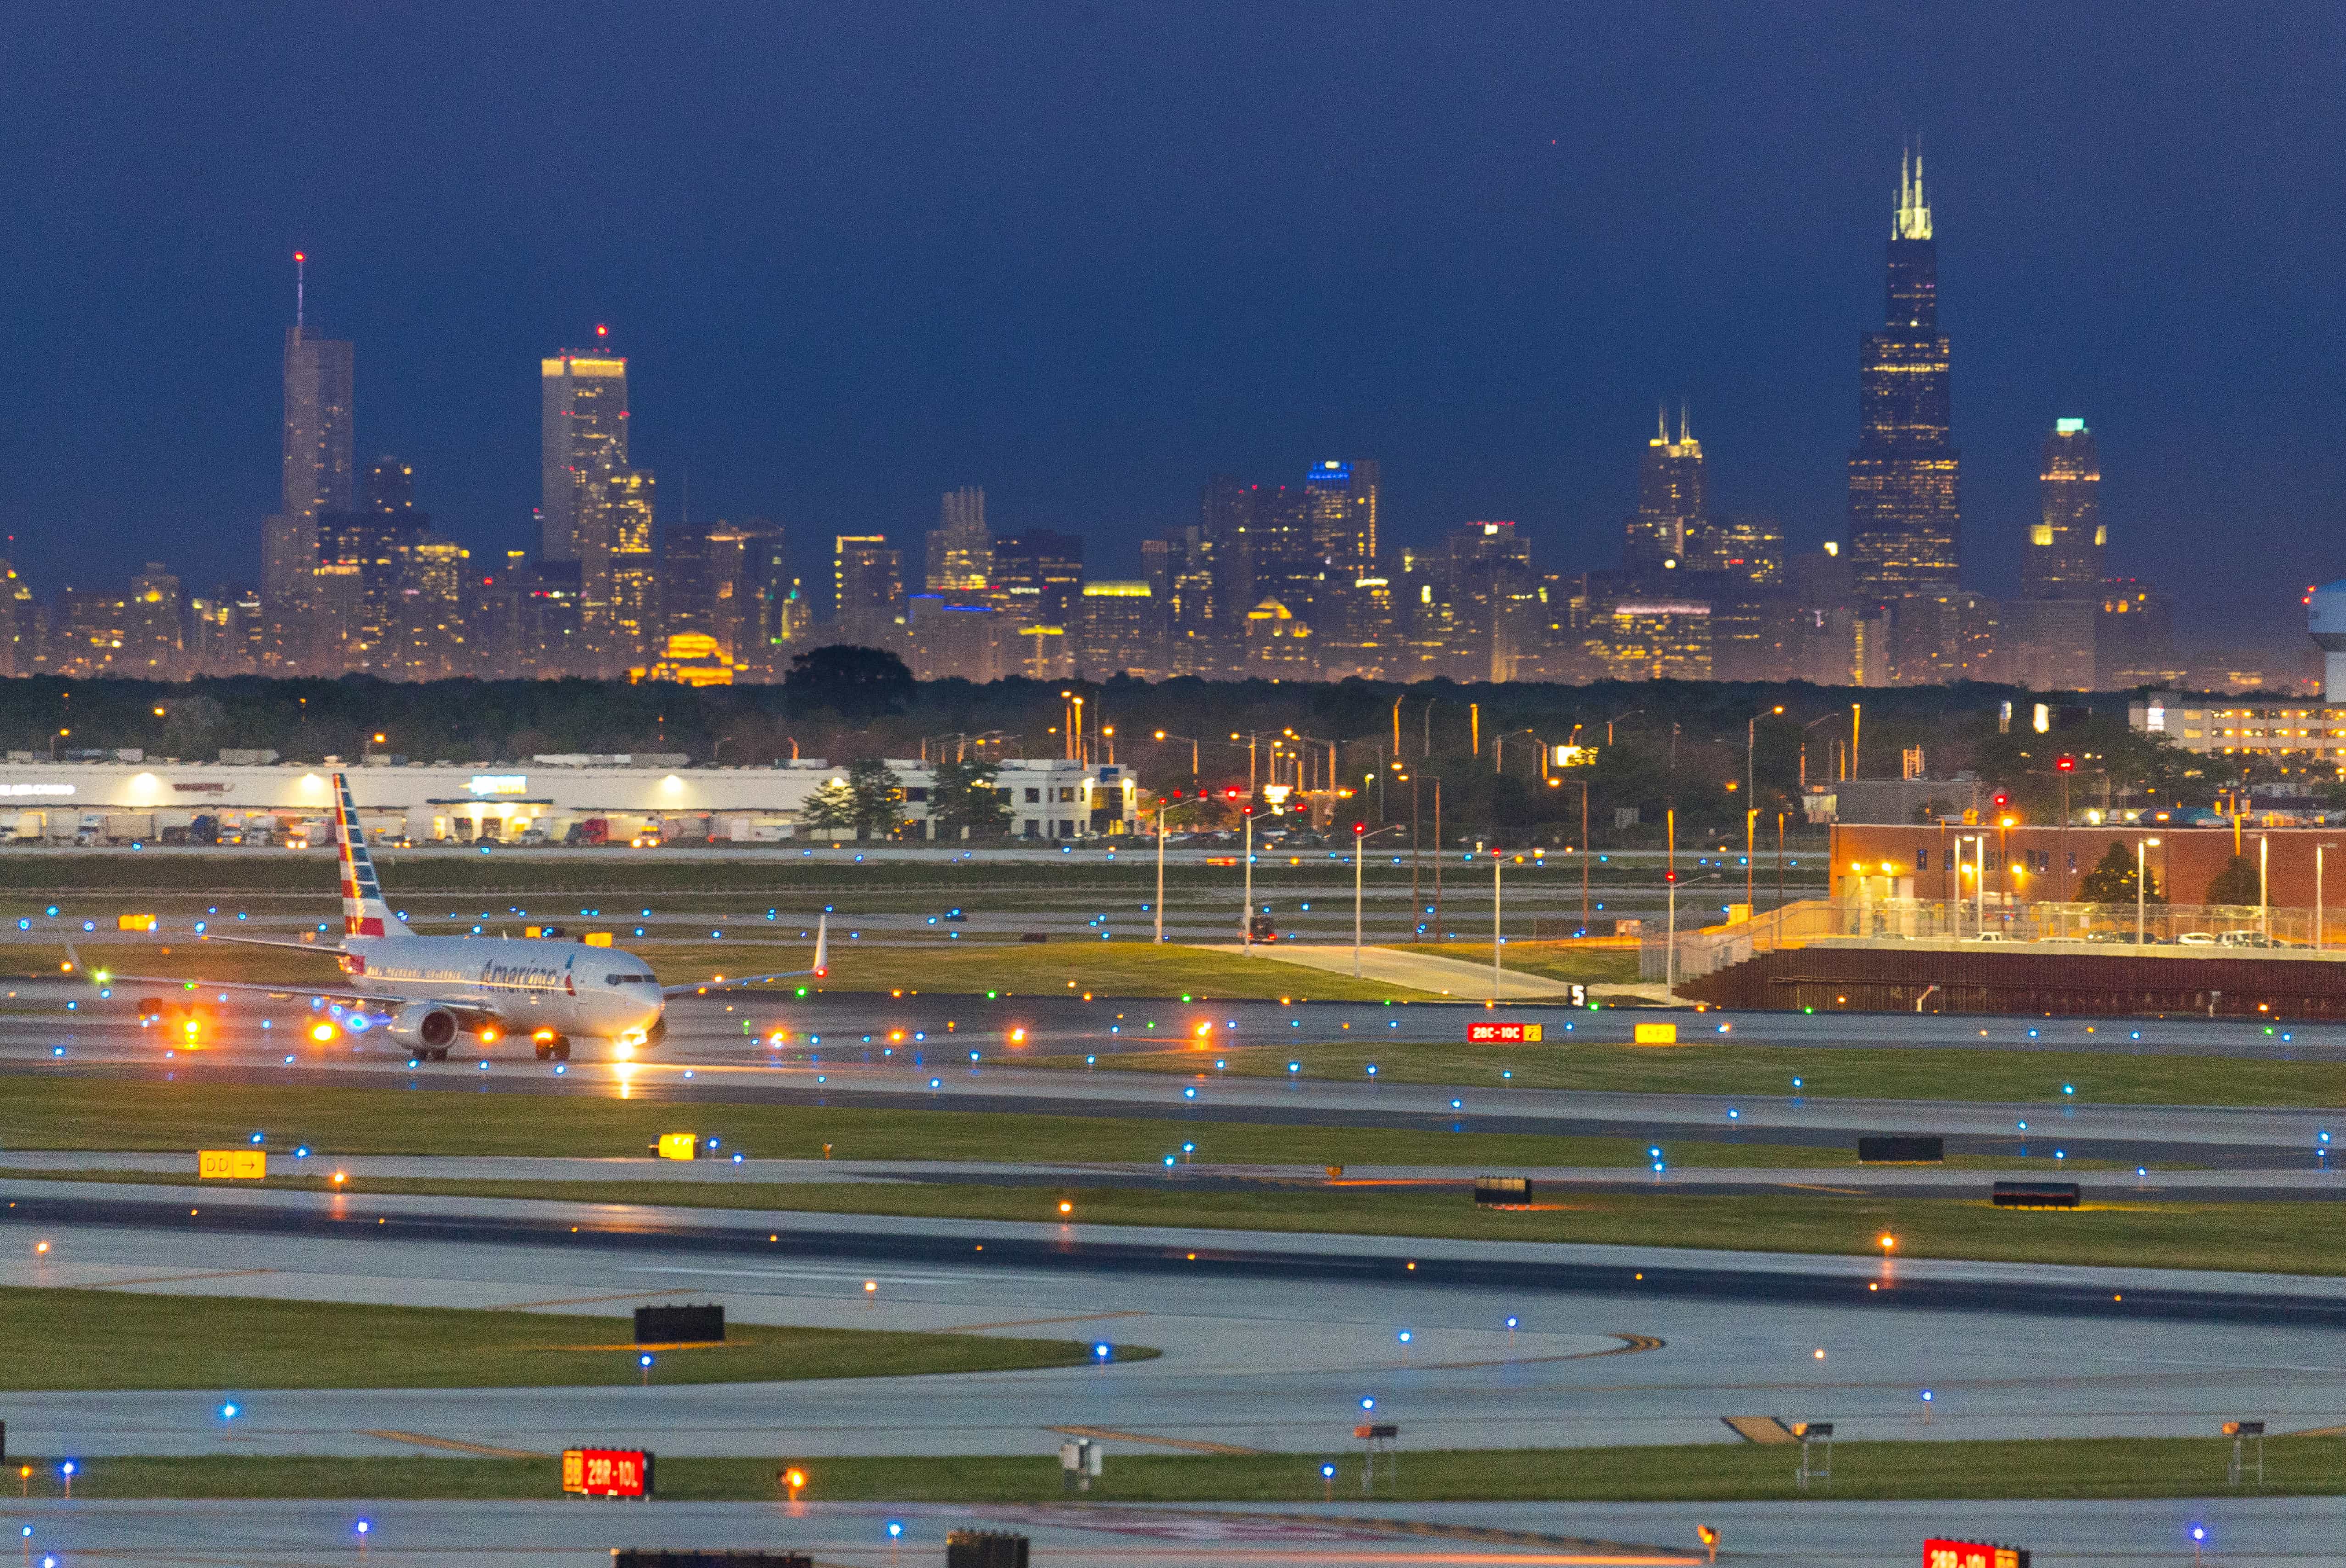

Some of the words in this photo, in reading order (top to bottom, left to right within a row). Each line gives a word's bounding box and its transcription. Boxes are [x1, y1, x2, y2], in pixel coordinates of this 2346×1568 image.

[480, 958, 557, 994] American
[1571, 985, 1585, 1006] 5
[1472, 1027, 1520, 1039] 28C-10C
[206, 1158, 229, 1172] DD
